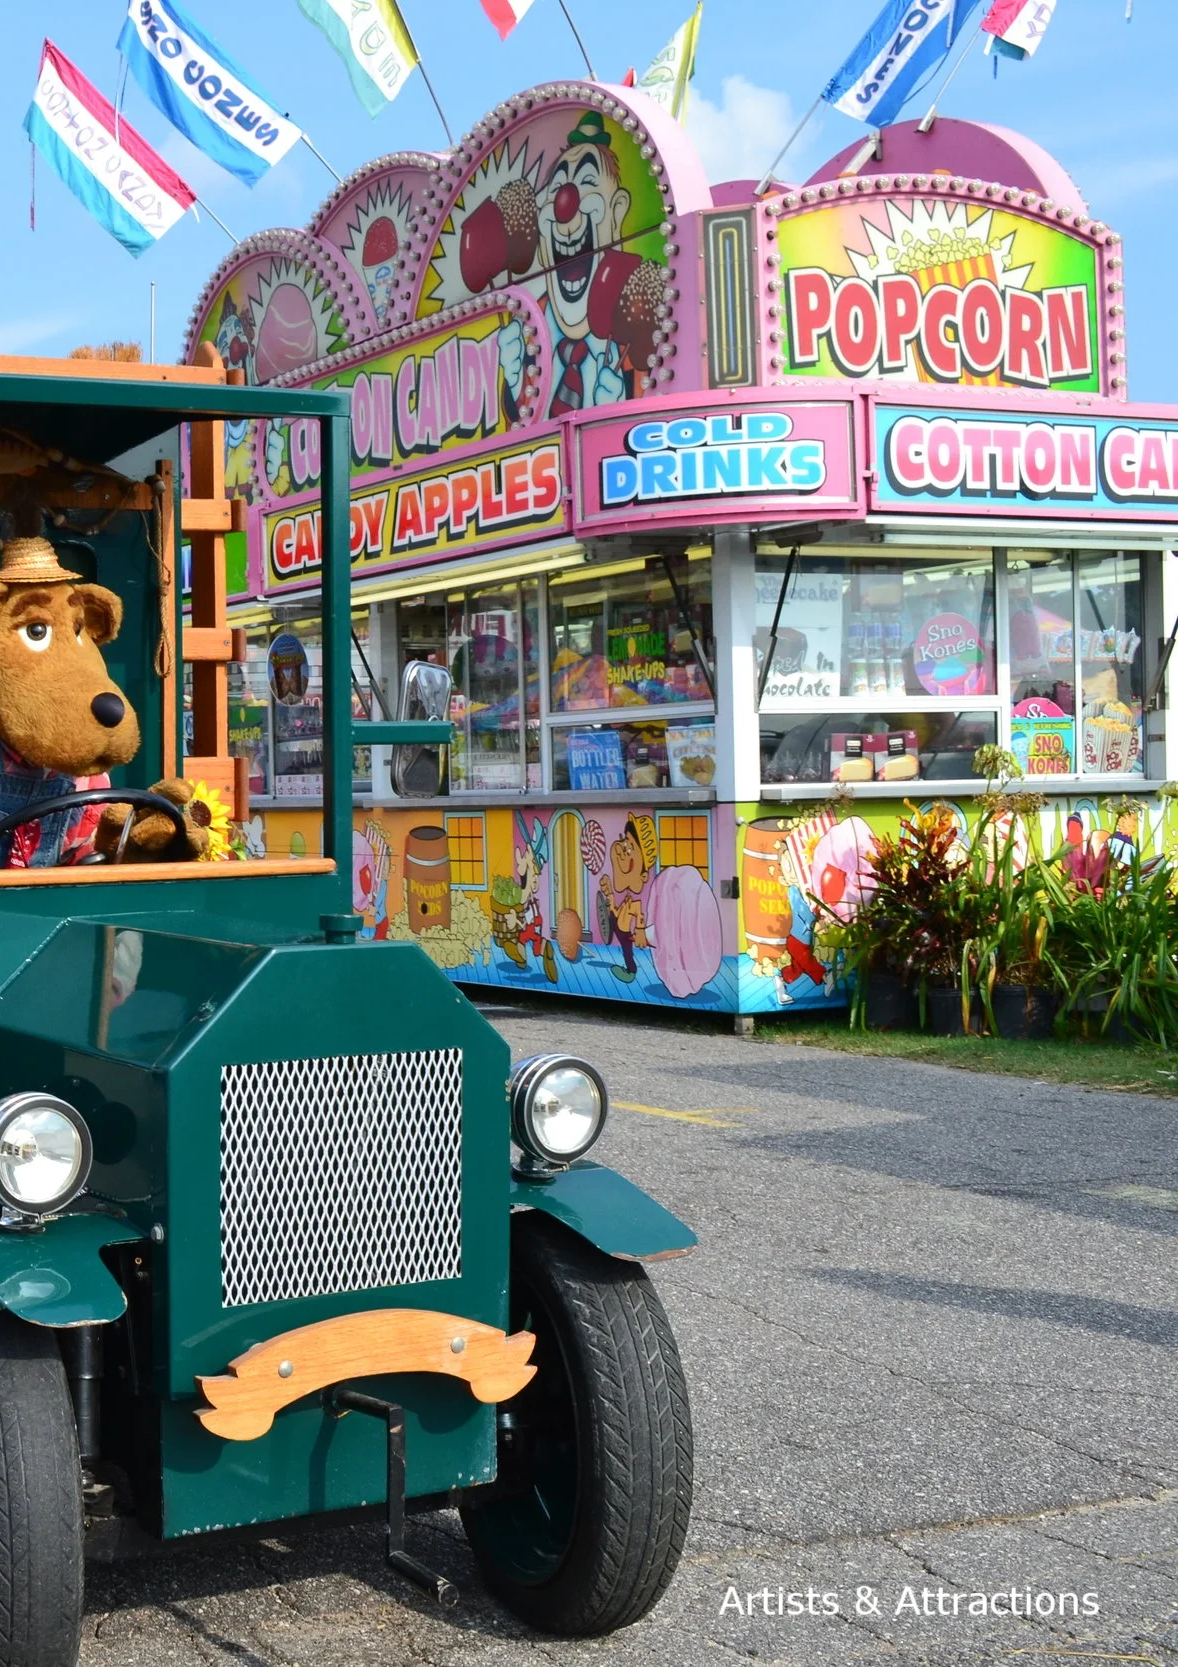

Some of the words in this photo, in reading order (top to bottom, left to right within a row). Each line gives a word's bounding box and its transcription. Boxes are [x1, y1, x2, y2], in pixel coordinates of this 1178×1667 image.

[183, 60, 279, 147] CONES
[790, 269, 1094, 383] POPCORN
[397, 337, 501, 451] CANDY
[630, 414, 791, 453] COLD
[603, 441, 825, 501] DRINKS
[892, 416, 1097, 494] COTTON
[273, 492, 388, 575] CADY
[393, 446, 560, 546] APPLES
[919, 638, 976, 662] Kones
[928, 624, 963, 642] Sno
[607, 660, 665, 685] SHAKE-UPS
[573, 749, 619, 768] BOTTLED
[1034, 733, 1063, 754] SNO
[580, 771, 620, 789] WATER
